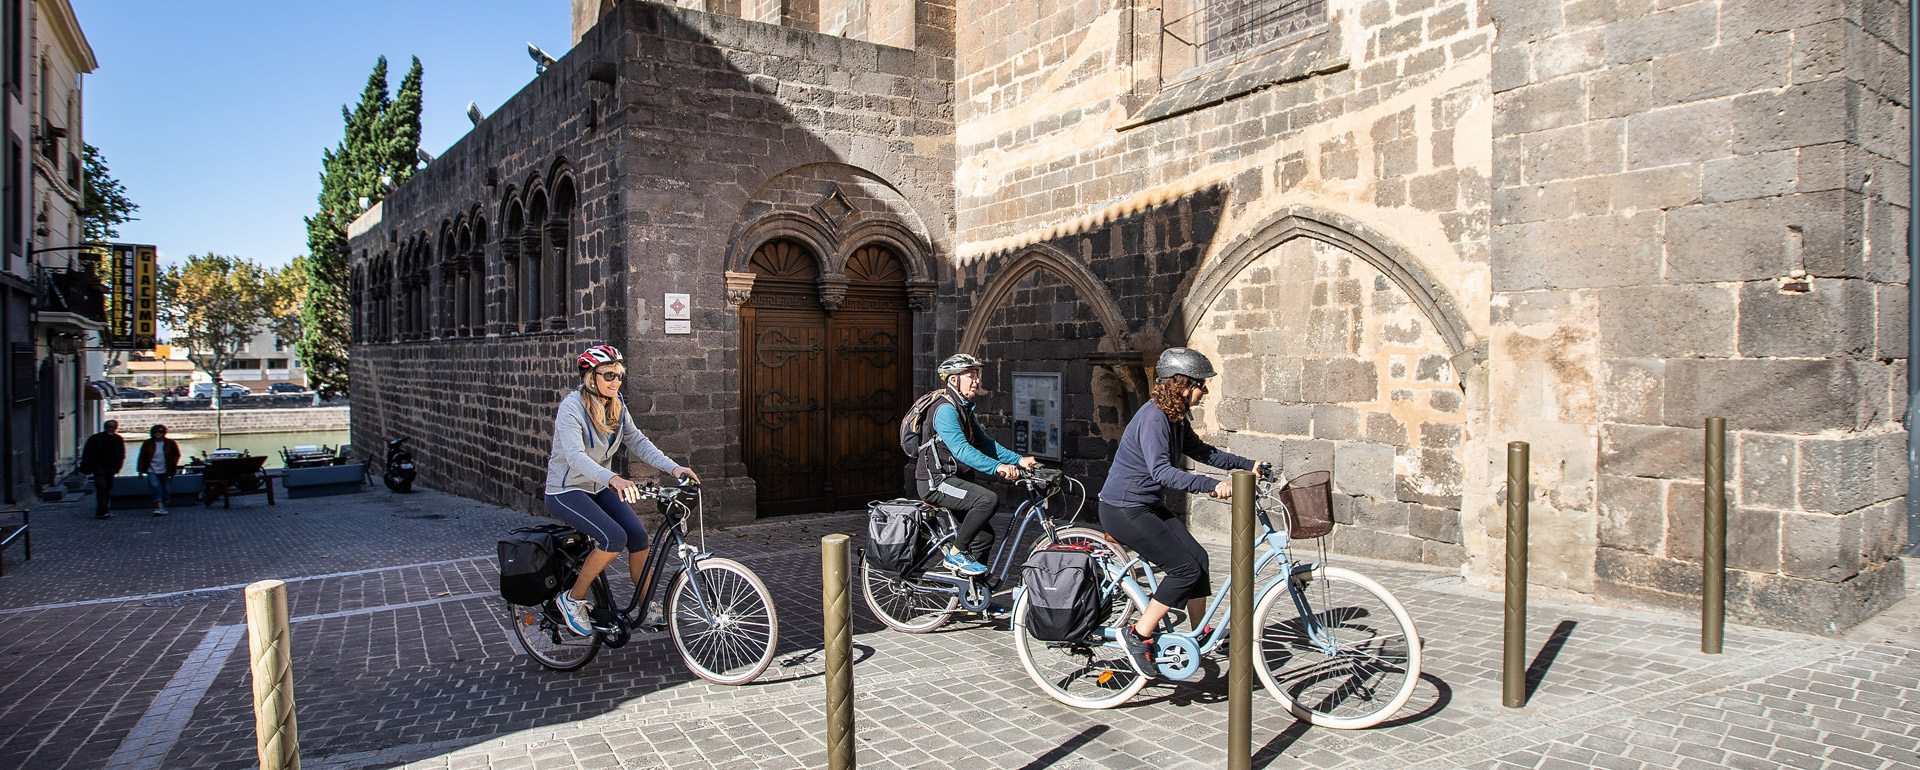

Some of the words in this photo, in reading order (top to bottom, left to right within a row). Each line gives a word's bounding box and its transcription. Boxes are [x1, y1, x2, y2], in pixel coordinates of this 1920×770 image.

[114, 250, 122, 335] RISTORANTE
[124, 320, 133, 336] 77
[140, 251, 152, 333] GIACOMO
